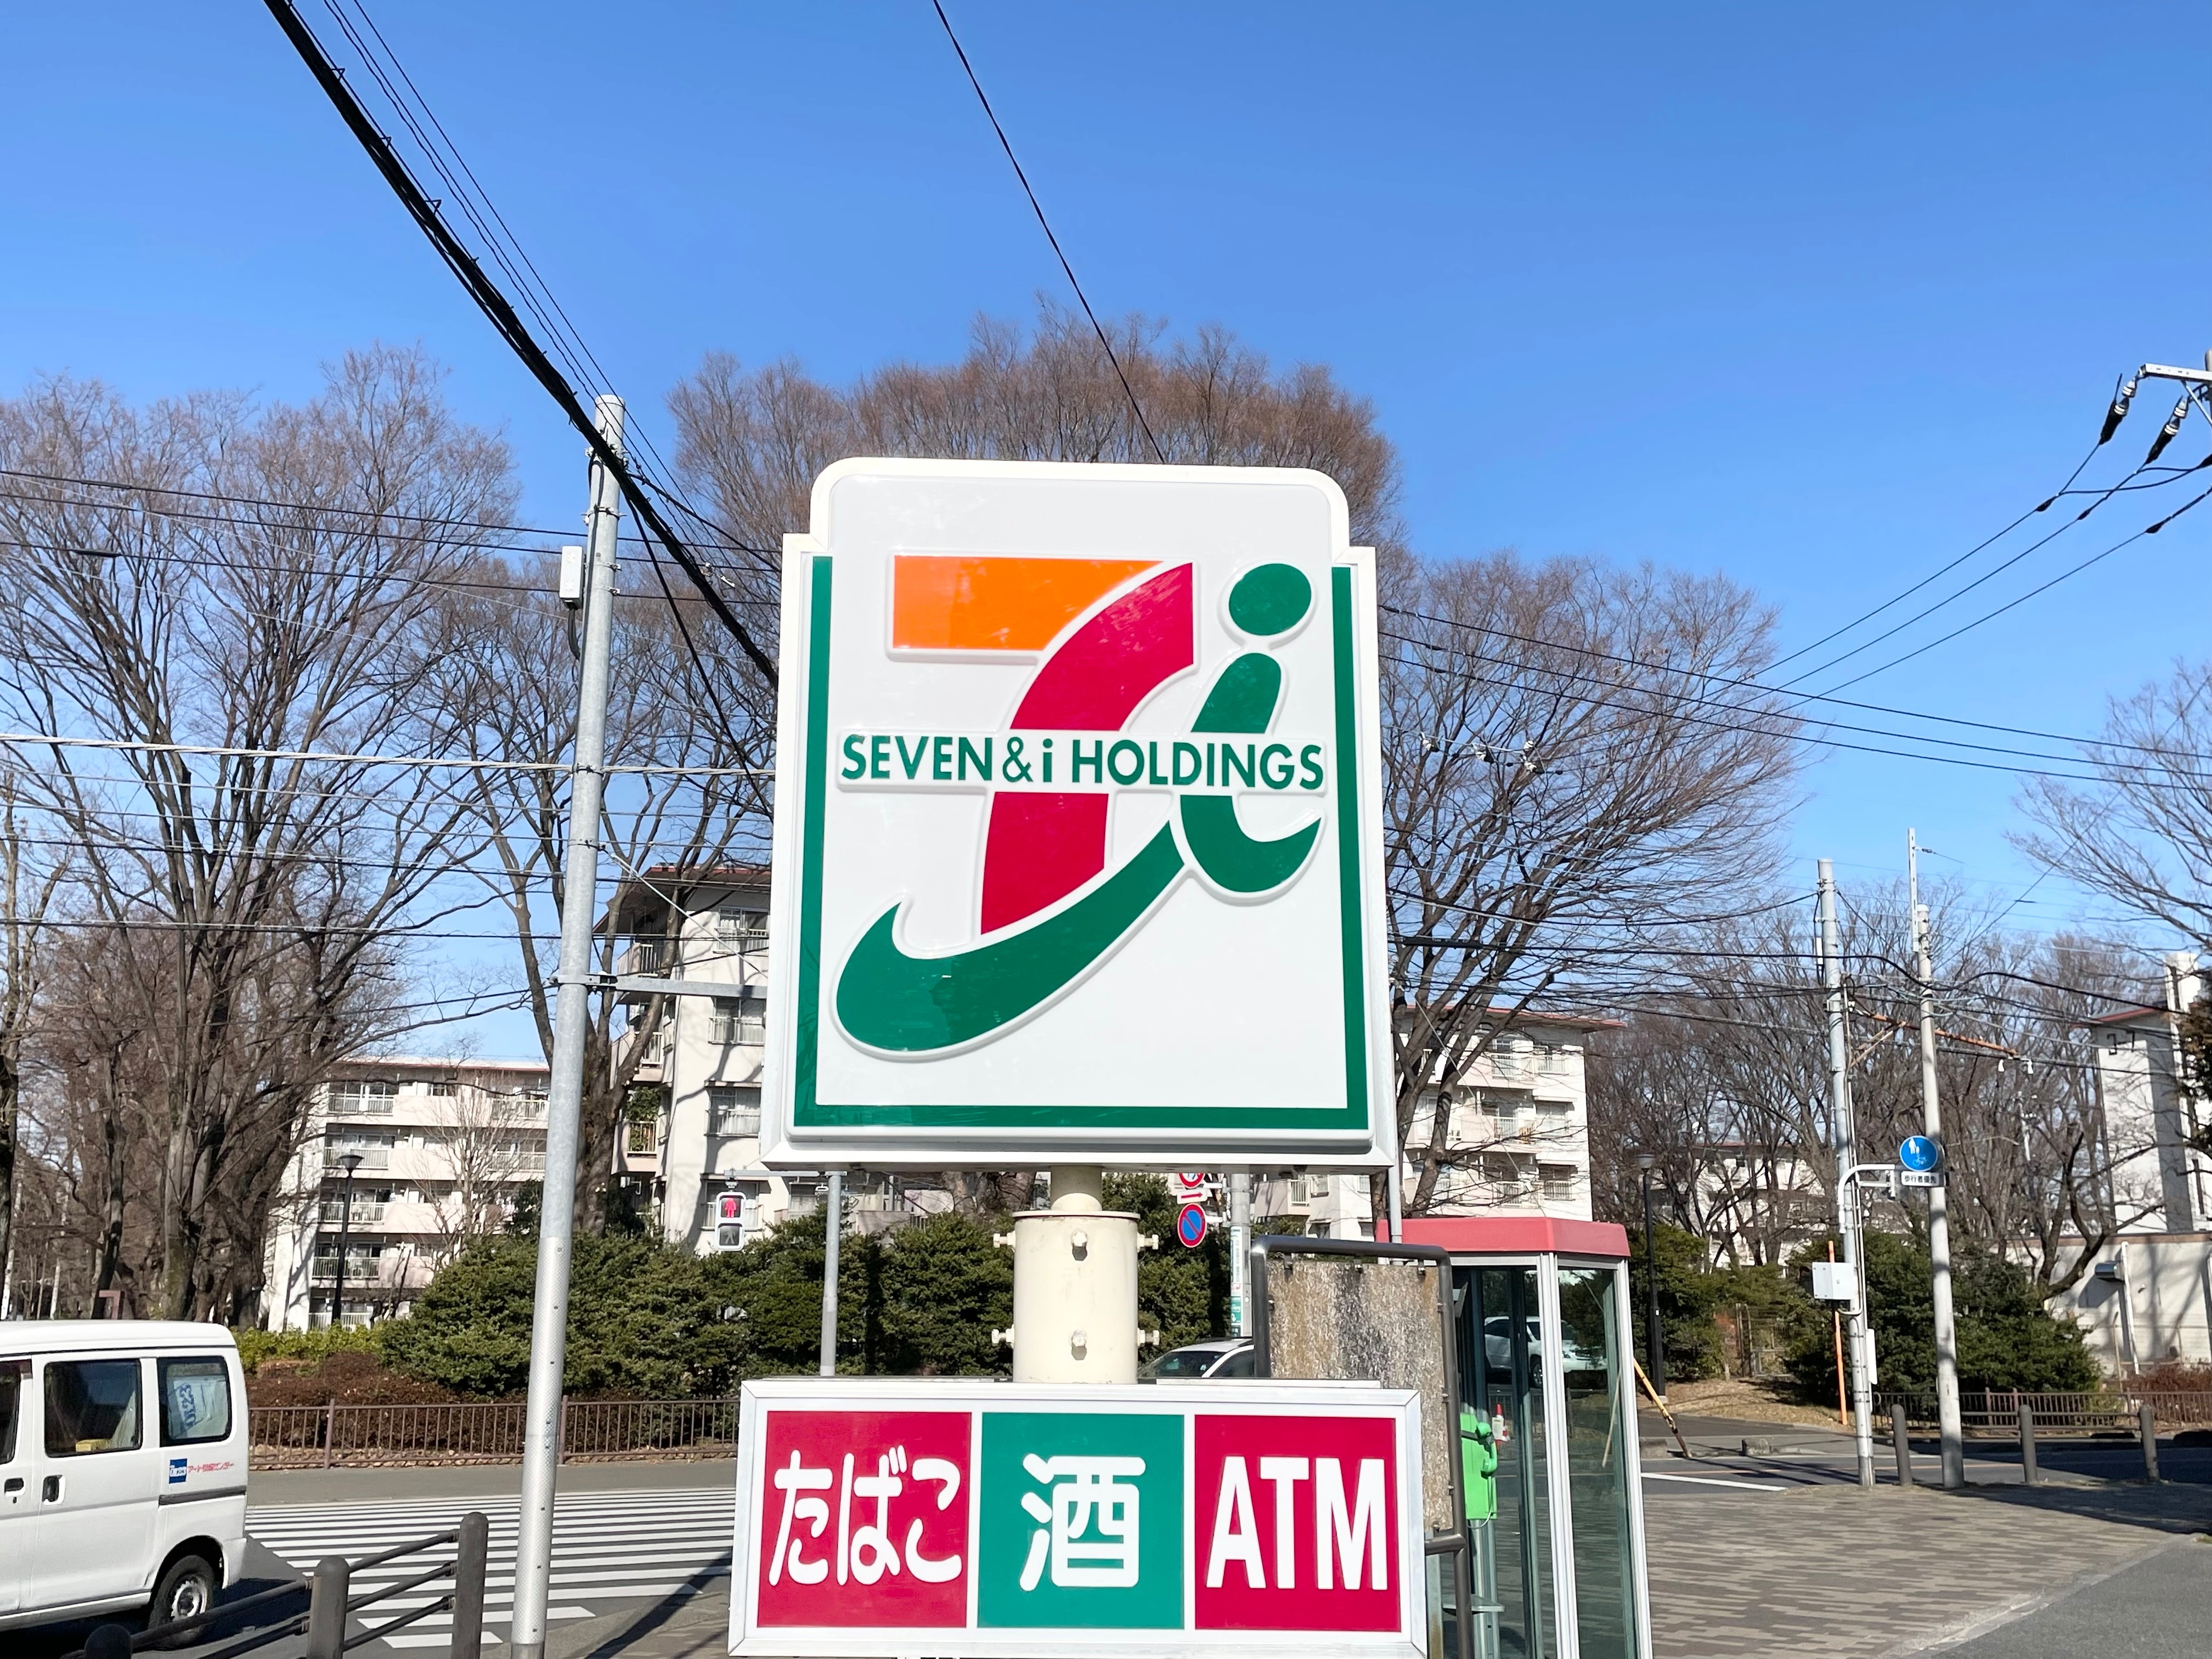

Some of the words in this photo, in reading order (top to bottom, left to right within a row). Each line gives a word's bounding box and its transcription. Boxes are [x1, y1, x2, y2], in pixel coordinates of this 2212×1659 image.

[1072, 739, 1324, 790] HOLDINGS
[1905, 1175, 1937, 1184] 歩行者優先
[769, 1445, 962, 1585] たばこ
[1020, 1453, 1146, 1591] 酒
[1206, 1457, 1387, 1590] ATM
